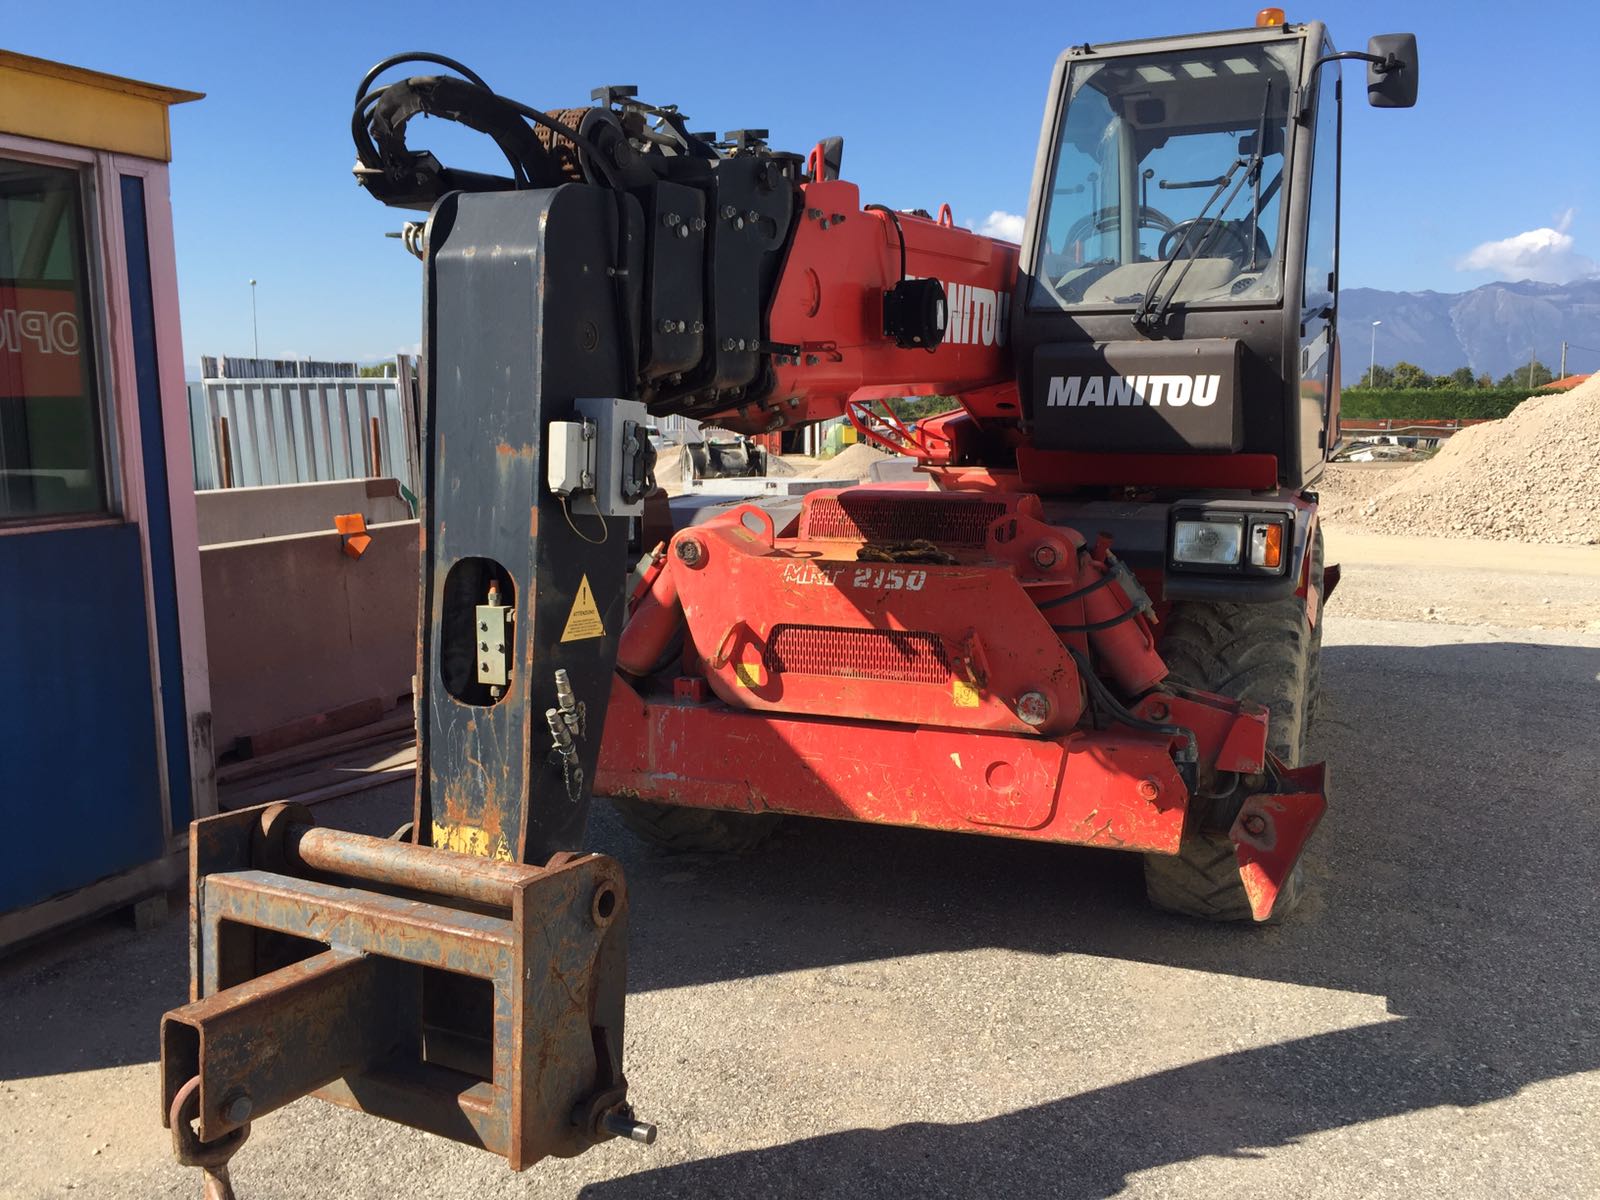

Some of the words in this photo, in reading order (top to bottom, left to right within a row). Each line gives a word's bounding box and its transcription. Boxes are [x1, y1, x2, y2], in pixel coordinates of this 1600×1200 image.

[905, 274, 1010, 347] NITOU
[1047, 375, 1221, 407] MANITOU
[853, 567, 927, 591] 2150
